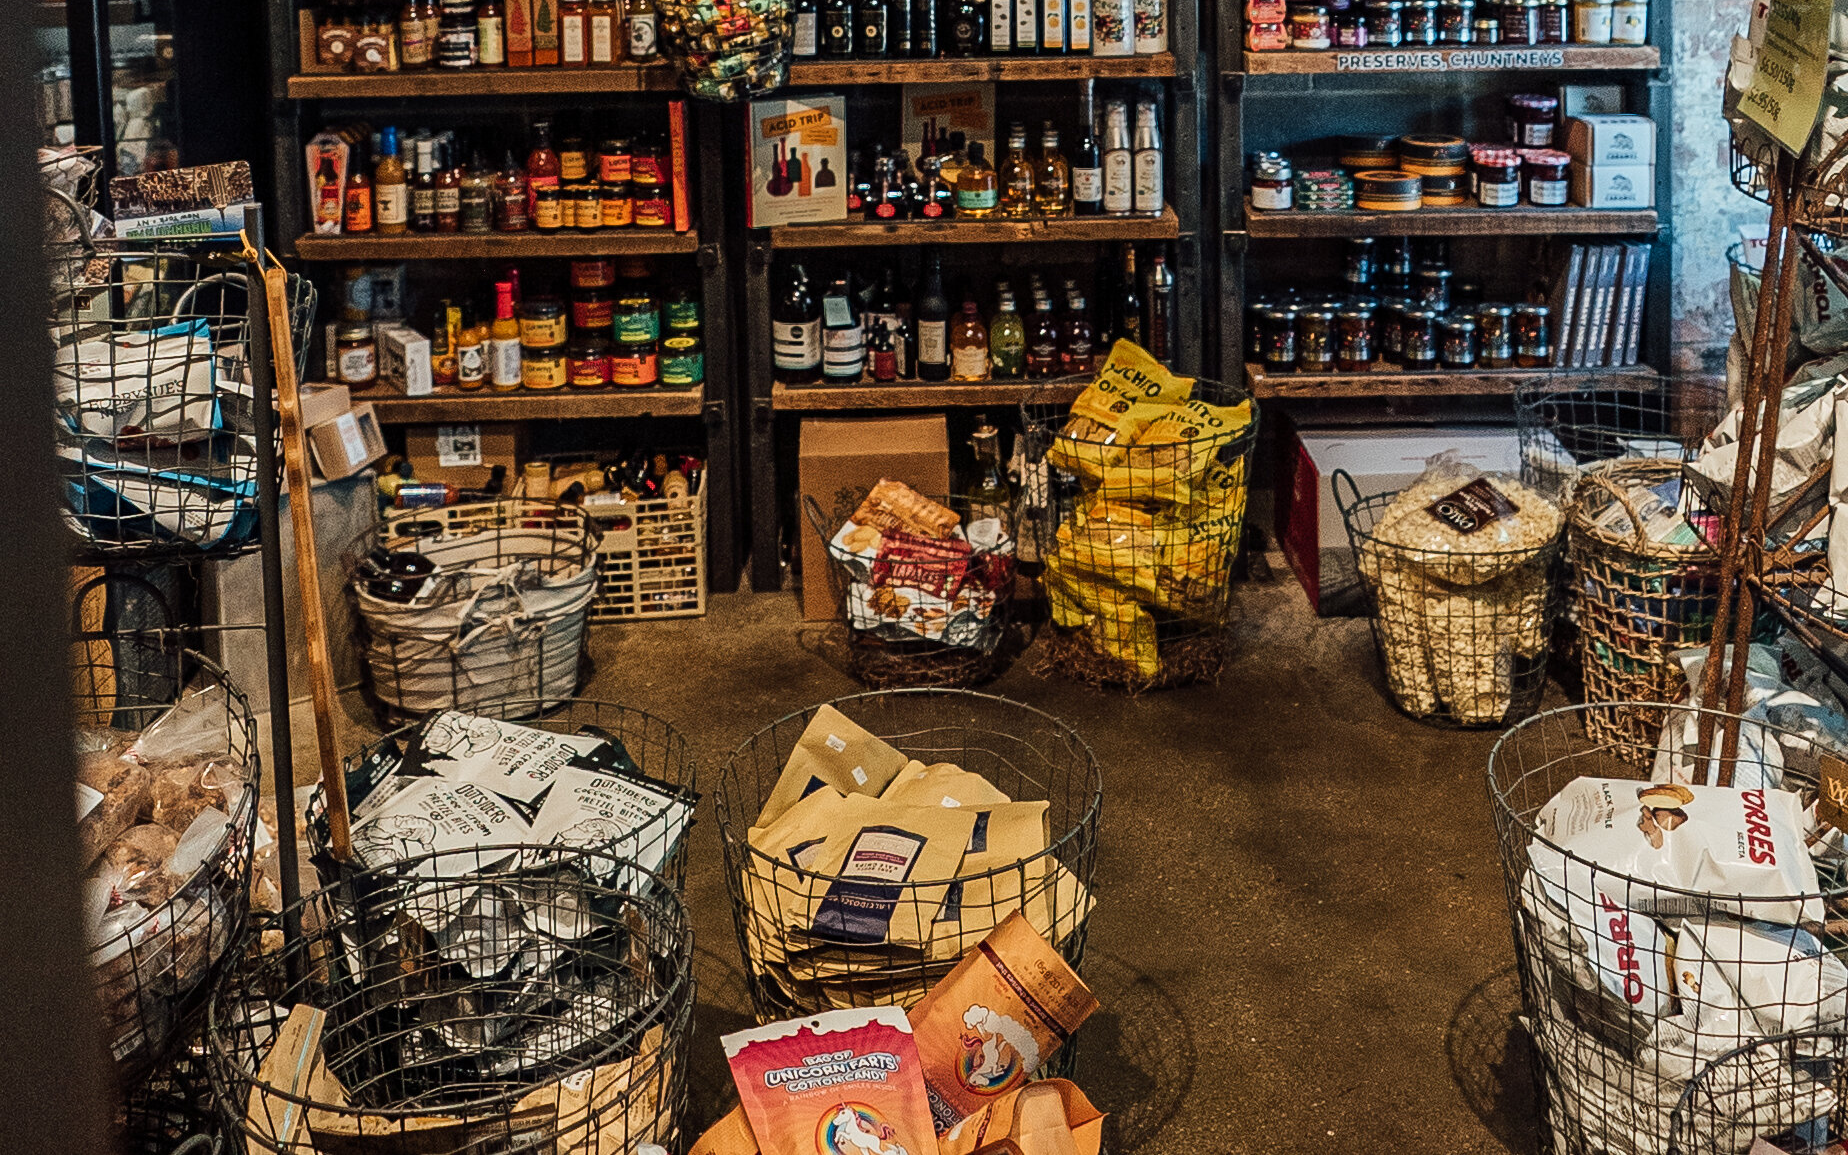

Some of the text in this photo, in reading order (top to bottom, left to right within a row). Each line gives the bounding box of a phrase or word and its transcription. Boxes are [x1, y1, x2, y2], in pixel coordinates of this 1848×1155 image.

[1338, 49, 1564, 71] PRESERVES, CHUNTNEYS
[769, 112, 824, 133] ACID TRIP
[455, 783, 511, 824] OUTSIDERS
[590, 777, 658, 808] OUTSIDERS
[1740, 788, 1776, 866] TORRES
[804, 1050, 852, 1066] BAG OF
[766, 1064, 847, 1086] UNICORN
[787, 1070, 887, 1092] COTTON CANDY
[789, 1088, 828, 1102] RAINBOW
